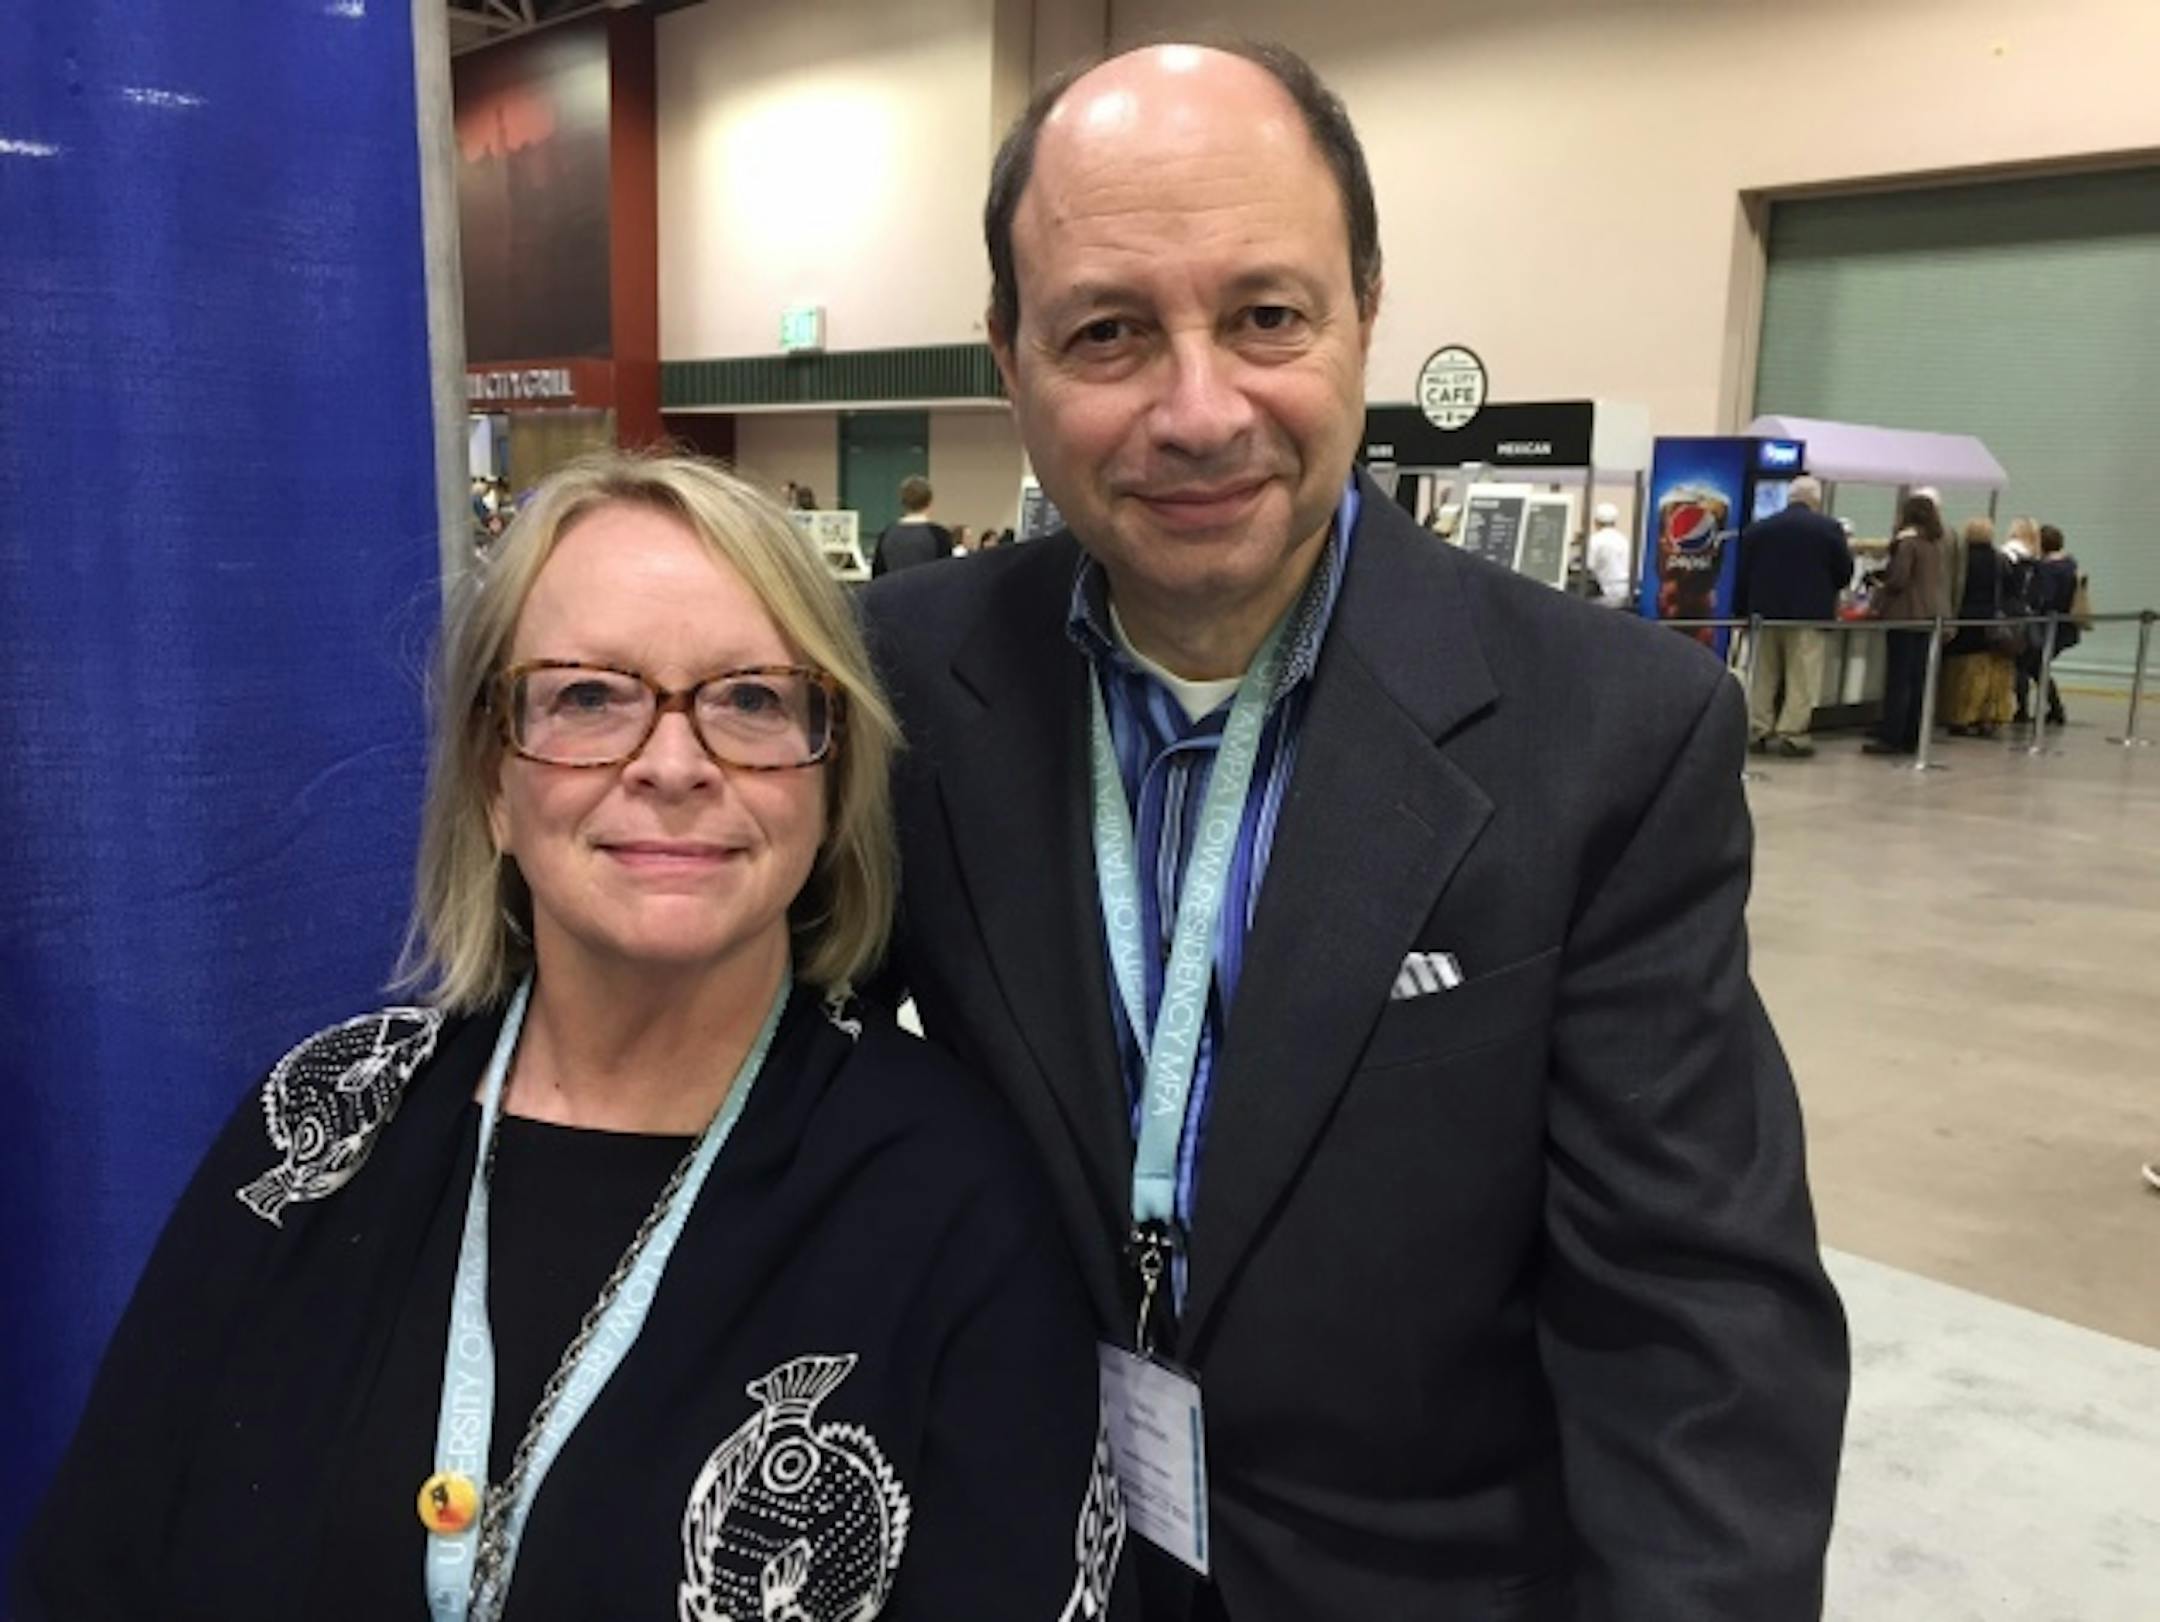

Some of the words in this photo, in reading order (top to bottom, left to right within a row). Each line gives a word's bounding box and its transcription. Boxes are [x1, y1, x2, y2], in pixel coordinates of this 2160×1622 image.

[1497, 442, 1551, 456] MEXICAN
[1217, 702, 1265, 796] TAMPA
[1096, 785, 1130, 883] TAMPA
[1114, 891, 1137, 931] OF
[1163, 804, 1233, 1048] LOW-RESIDENCY
[1152, 1052, 1184, 1117] MFA
[458, 1315, 486, 1362] OF
[437, 1371, 486, 1565] UERSITY
